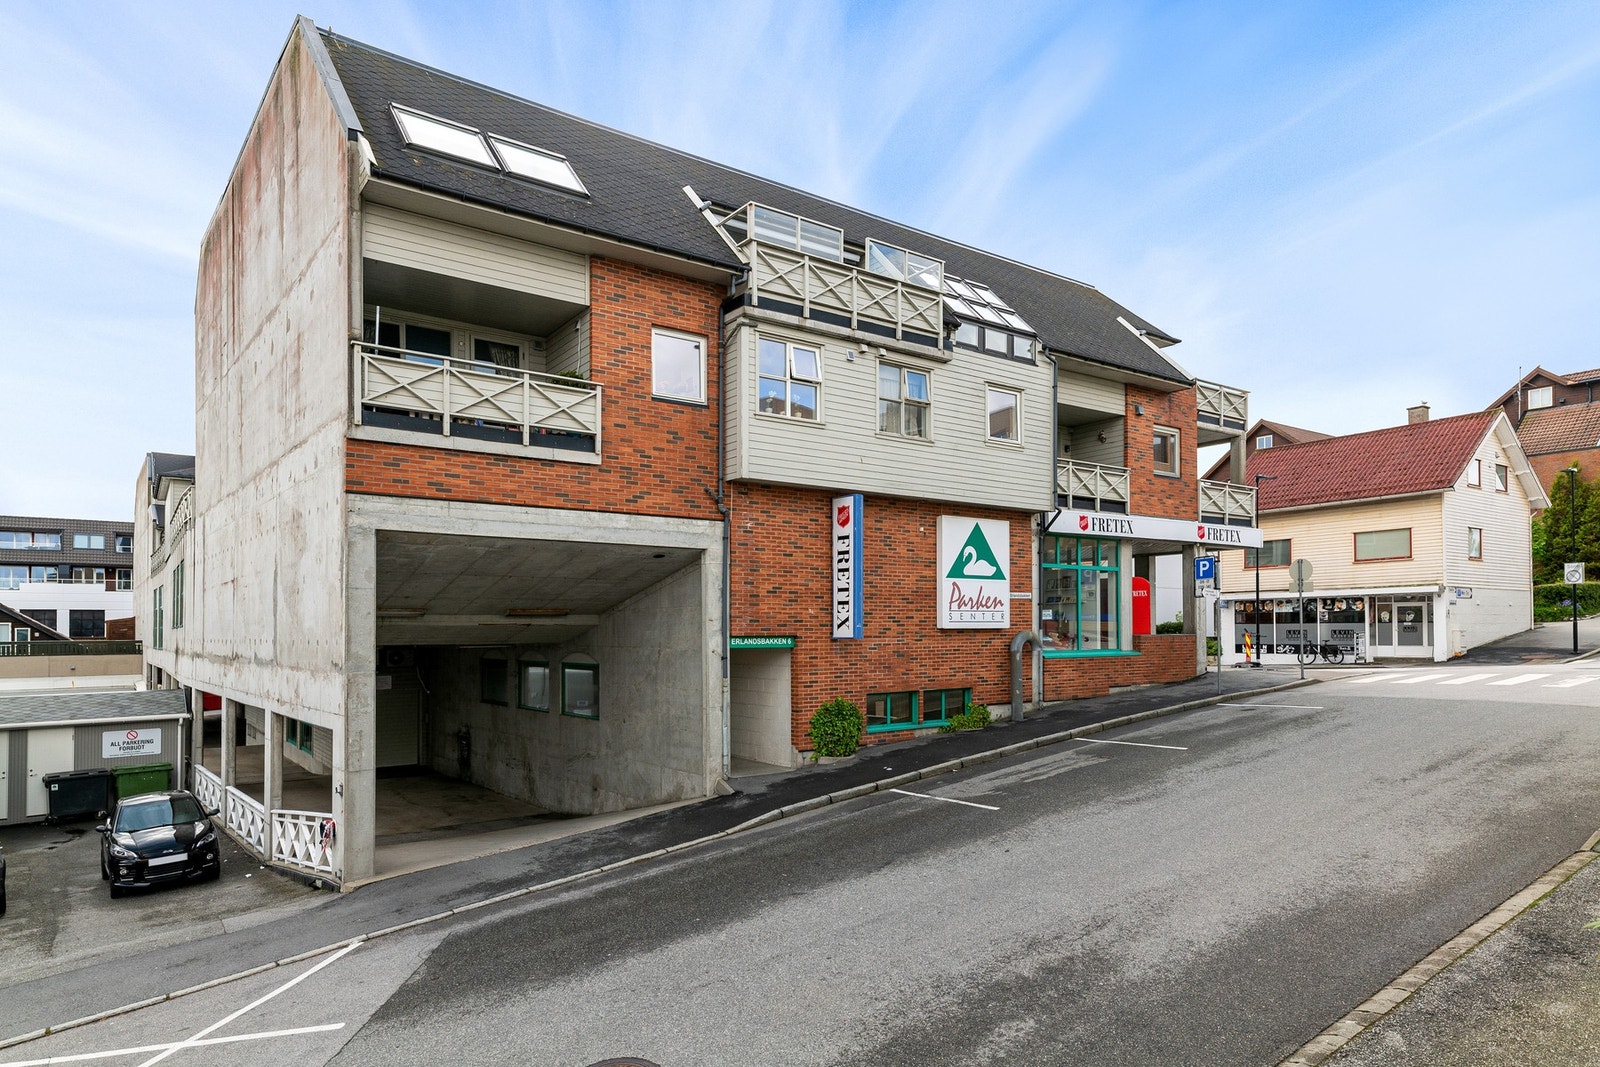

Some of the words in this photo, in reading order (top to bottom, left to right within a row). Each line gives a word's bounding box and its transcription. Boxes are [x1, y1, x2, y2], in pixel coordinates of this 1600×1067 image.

[1091, 517, 1134, 534] FRETEX
[1207, 527, 1242, 543] FRETEX
[1199, 560, 1210, 577] P
[836, 533, 850, 632] FRETEX
[948, 581, 1004, 611] Parken
[948, 612, 1005, 621] SENTER
[731, 637, 787, 645] ERLANDSBAKKEN
[787, 637, 792, 645] 6
